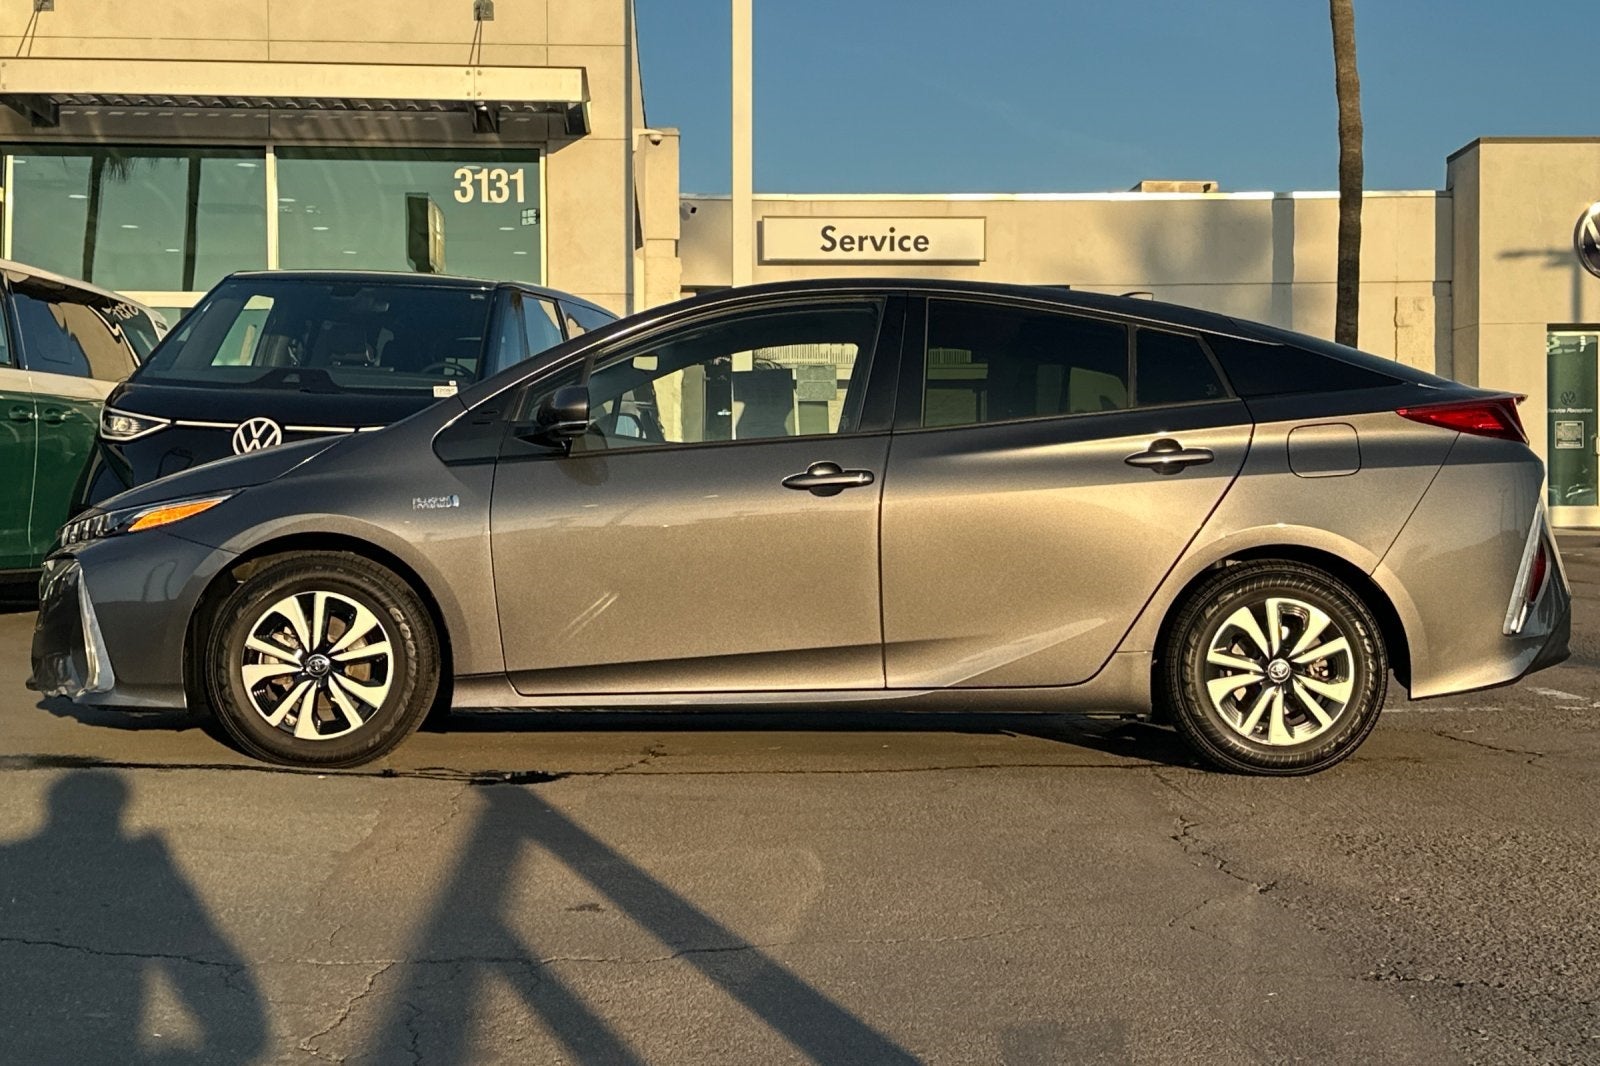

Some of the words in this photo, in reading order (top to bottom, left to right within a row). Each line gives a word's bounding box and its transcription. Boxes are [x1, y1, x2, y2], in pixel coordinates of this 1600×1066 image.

[454, 171, 525, 203] 3131
[820, 225, 930, 252] Service
[367, 607, 416, 748] GOODYEAR
